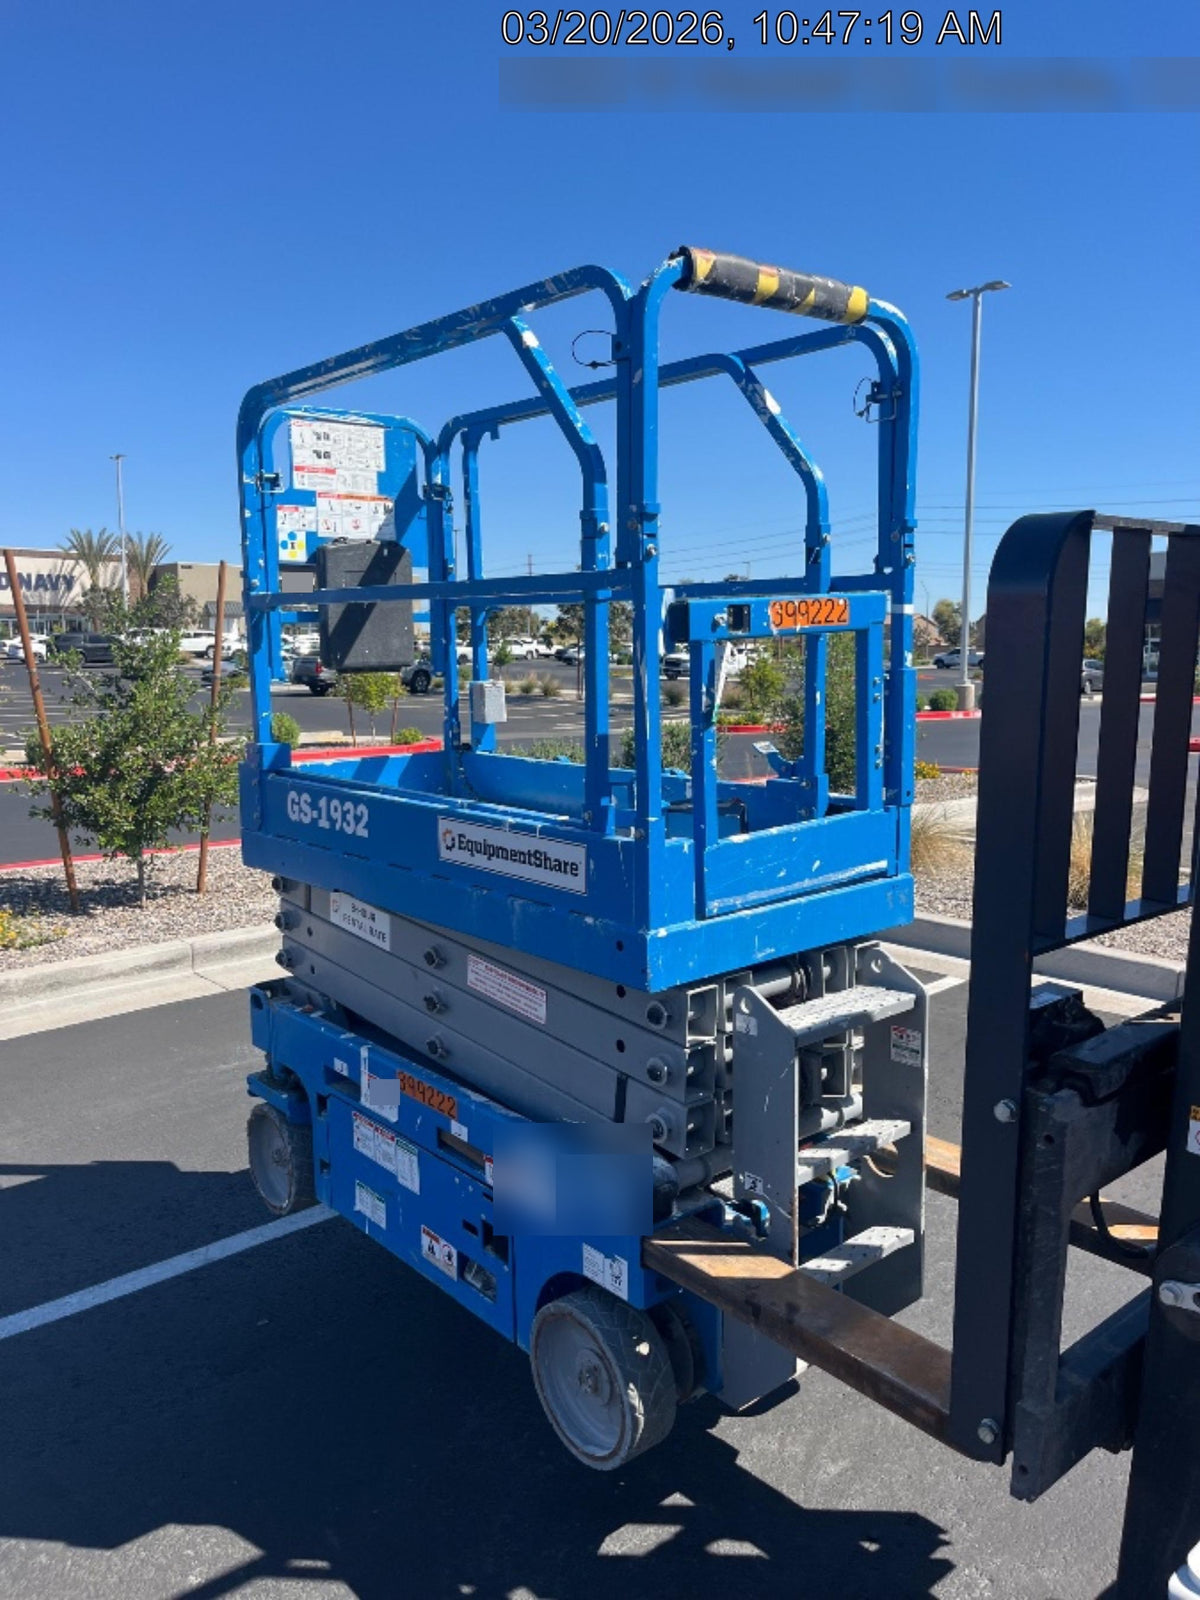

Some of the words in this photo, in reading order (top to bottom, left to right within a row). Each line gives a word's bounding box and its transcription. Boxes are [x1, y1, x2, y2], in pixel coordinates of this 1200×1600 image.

[17, 572, 75, 592] NAVY
[771, 598, 848, 627] 399222
[287, 790, 369, 838] GS-1932
[457, 833, 579, 877] EquipmentShare
